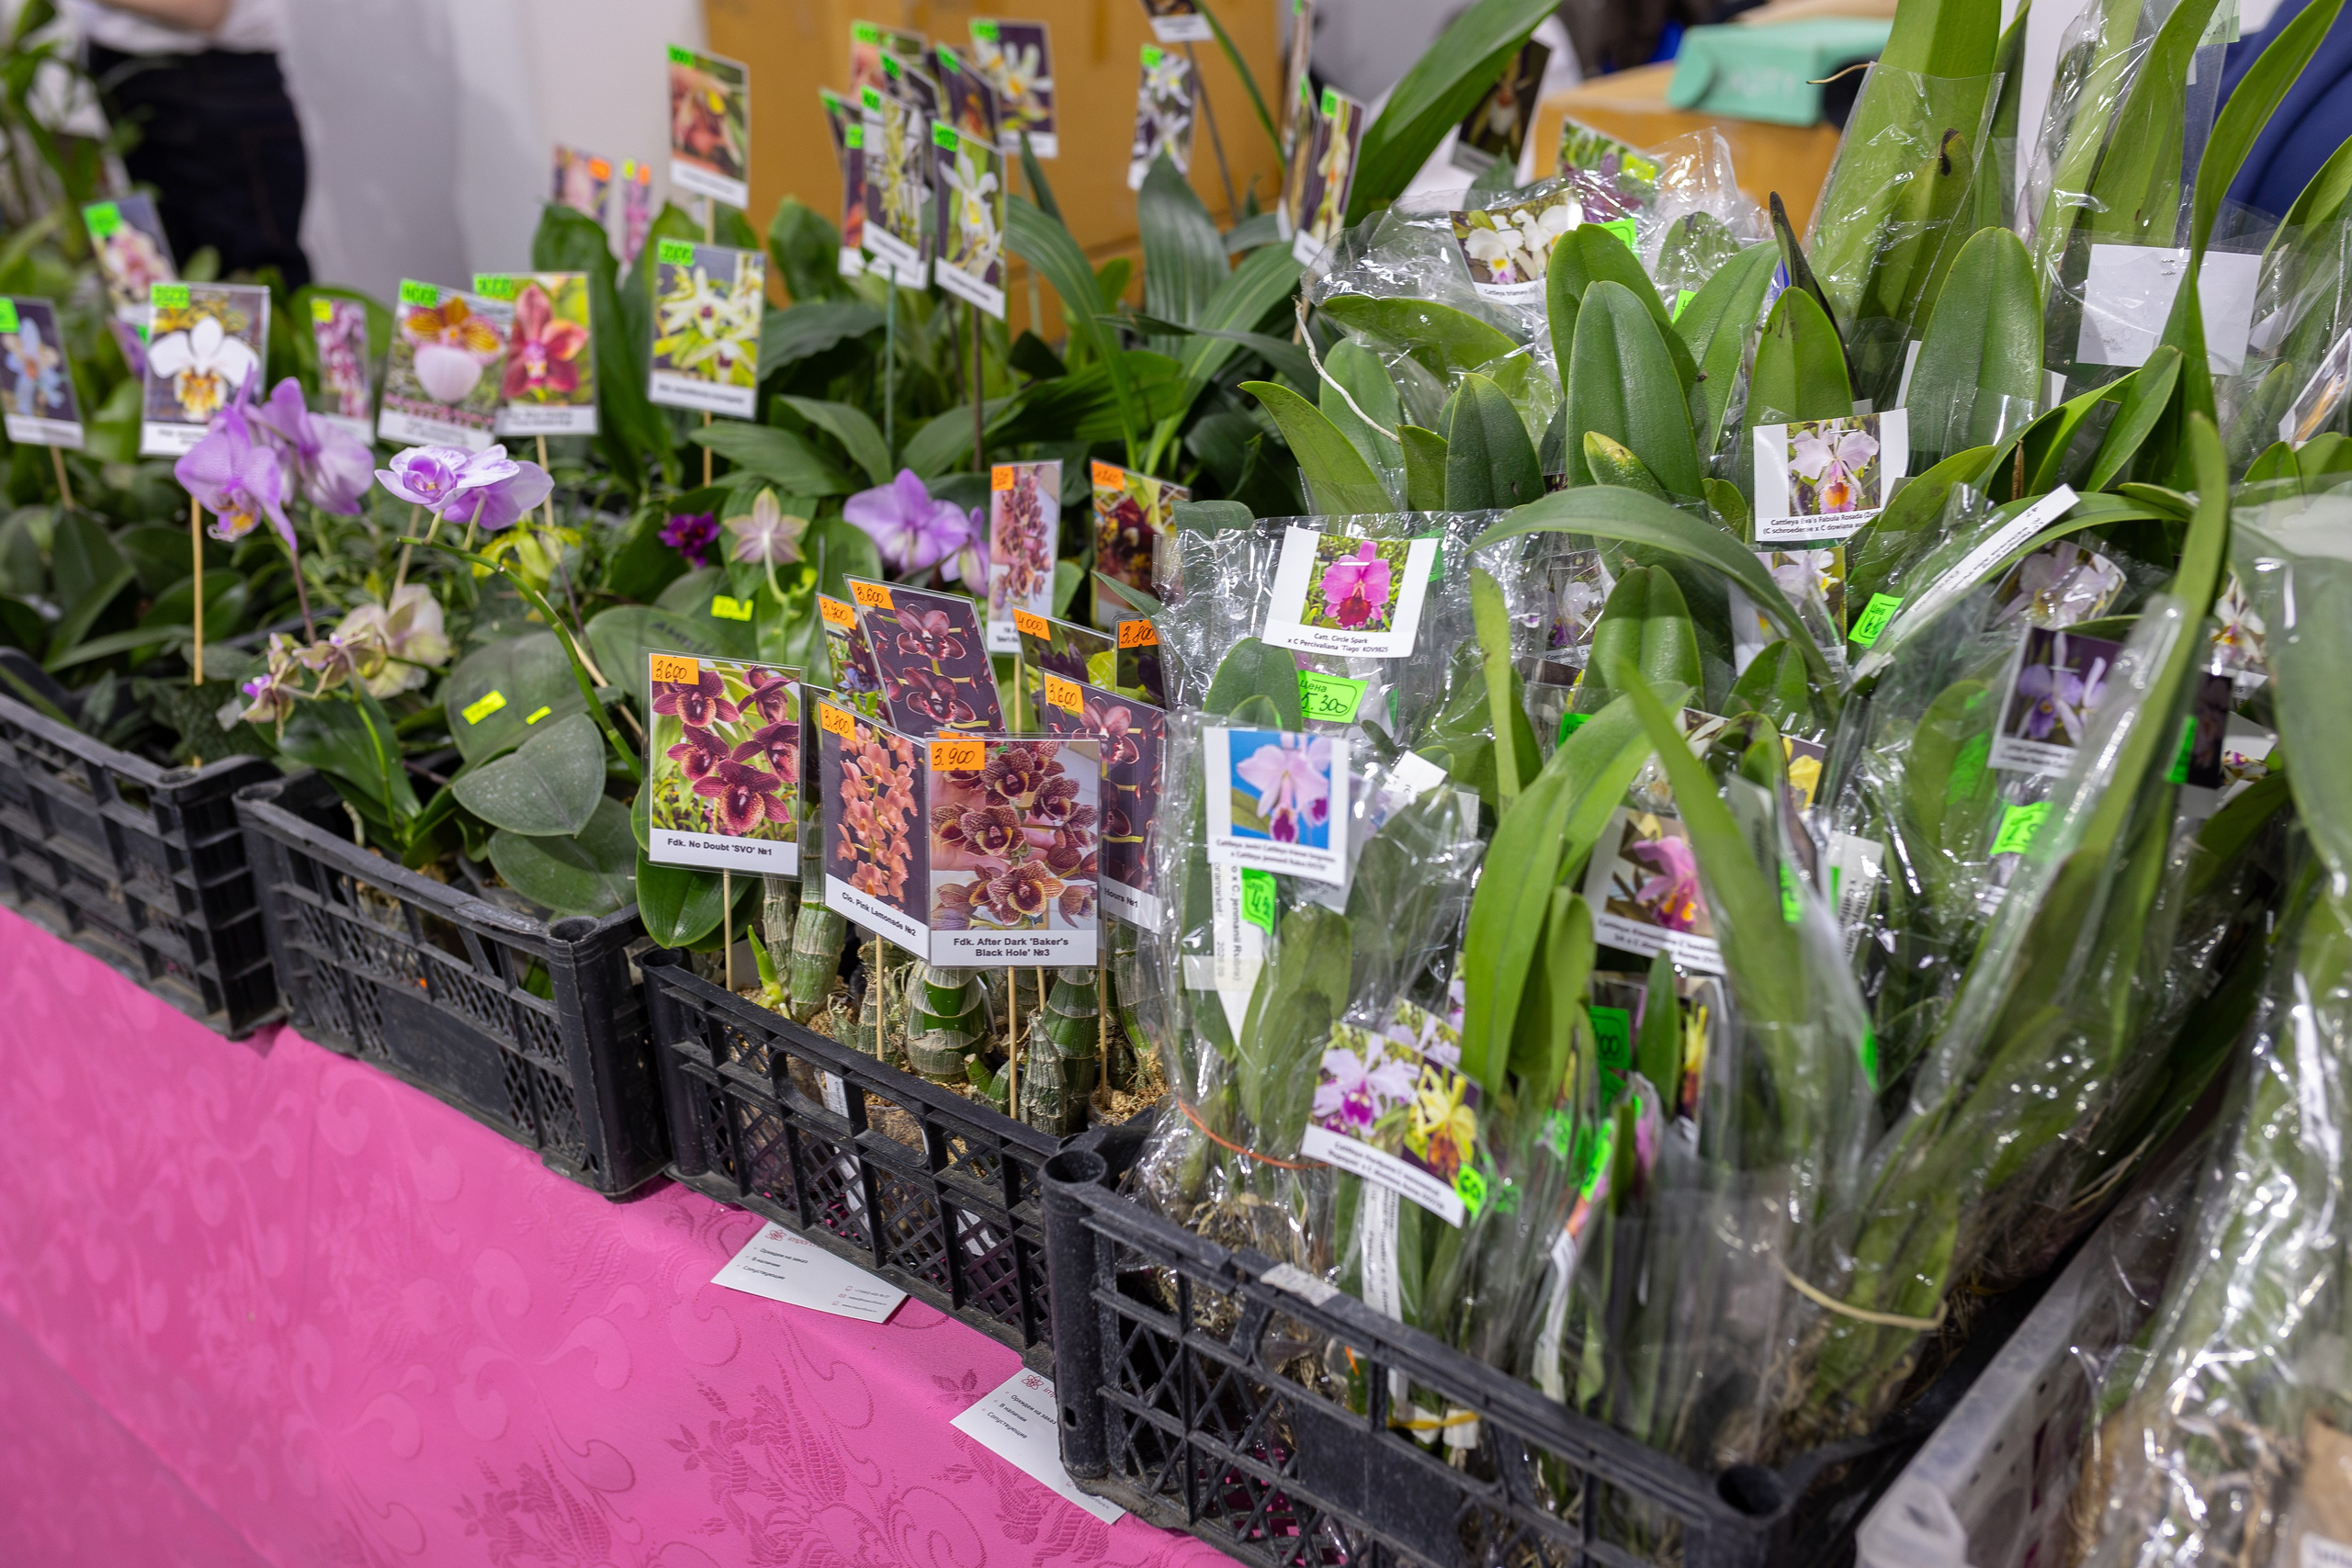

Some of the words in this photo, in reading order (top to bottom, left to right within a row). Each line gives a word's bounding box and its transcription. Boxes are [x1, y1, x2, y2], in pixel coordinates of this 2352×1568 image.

[1770, 519, 1799, 527] Cattleya
[656, 660, 687, 680] 3.600
[1300, 680, 1327, 693] Цена
[1048, 683, 1078, 707] 3.600
[933, 748, 975, 766] 3.900
[668, 838, 686, 847] Fdk.
[689, 840, 701, 849] No
[704, 842, 729, 852] Doubt
[1104, 887, 1125, 902] Hours
[855, 899, 870, 913] Pink
[871, 907, 903, 931] Lemonade
[954, 938, 975, 946] Fdk.
[977, 938, 1001, 946] After
[1004, 938, 1027, 946] Dark
[976, 949, 1002, 957] Black
[1011, 1394, 1035, 1412] Орхидеи
[1003, 1406, 1027, 1422] наличии
